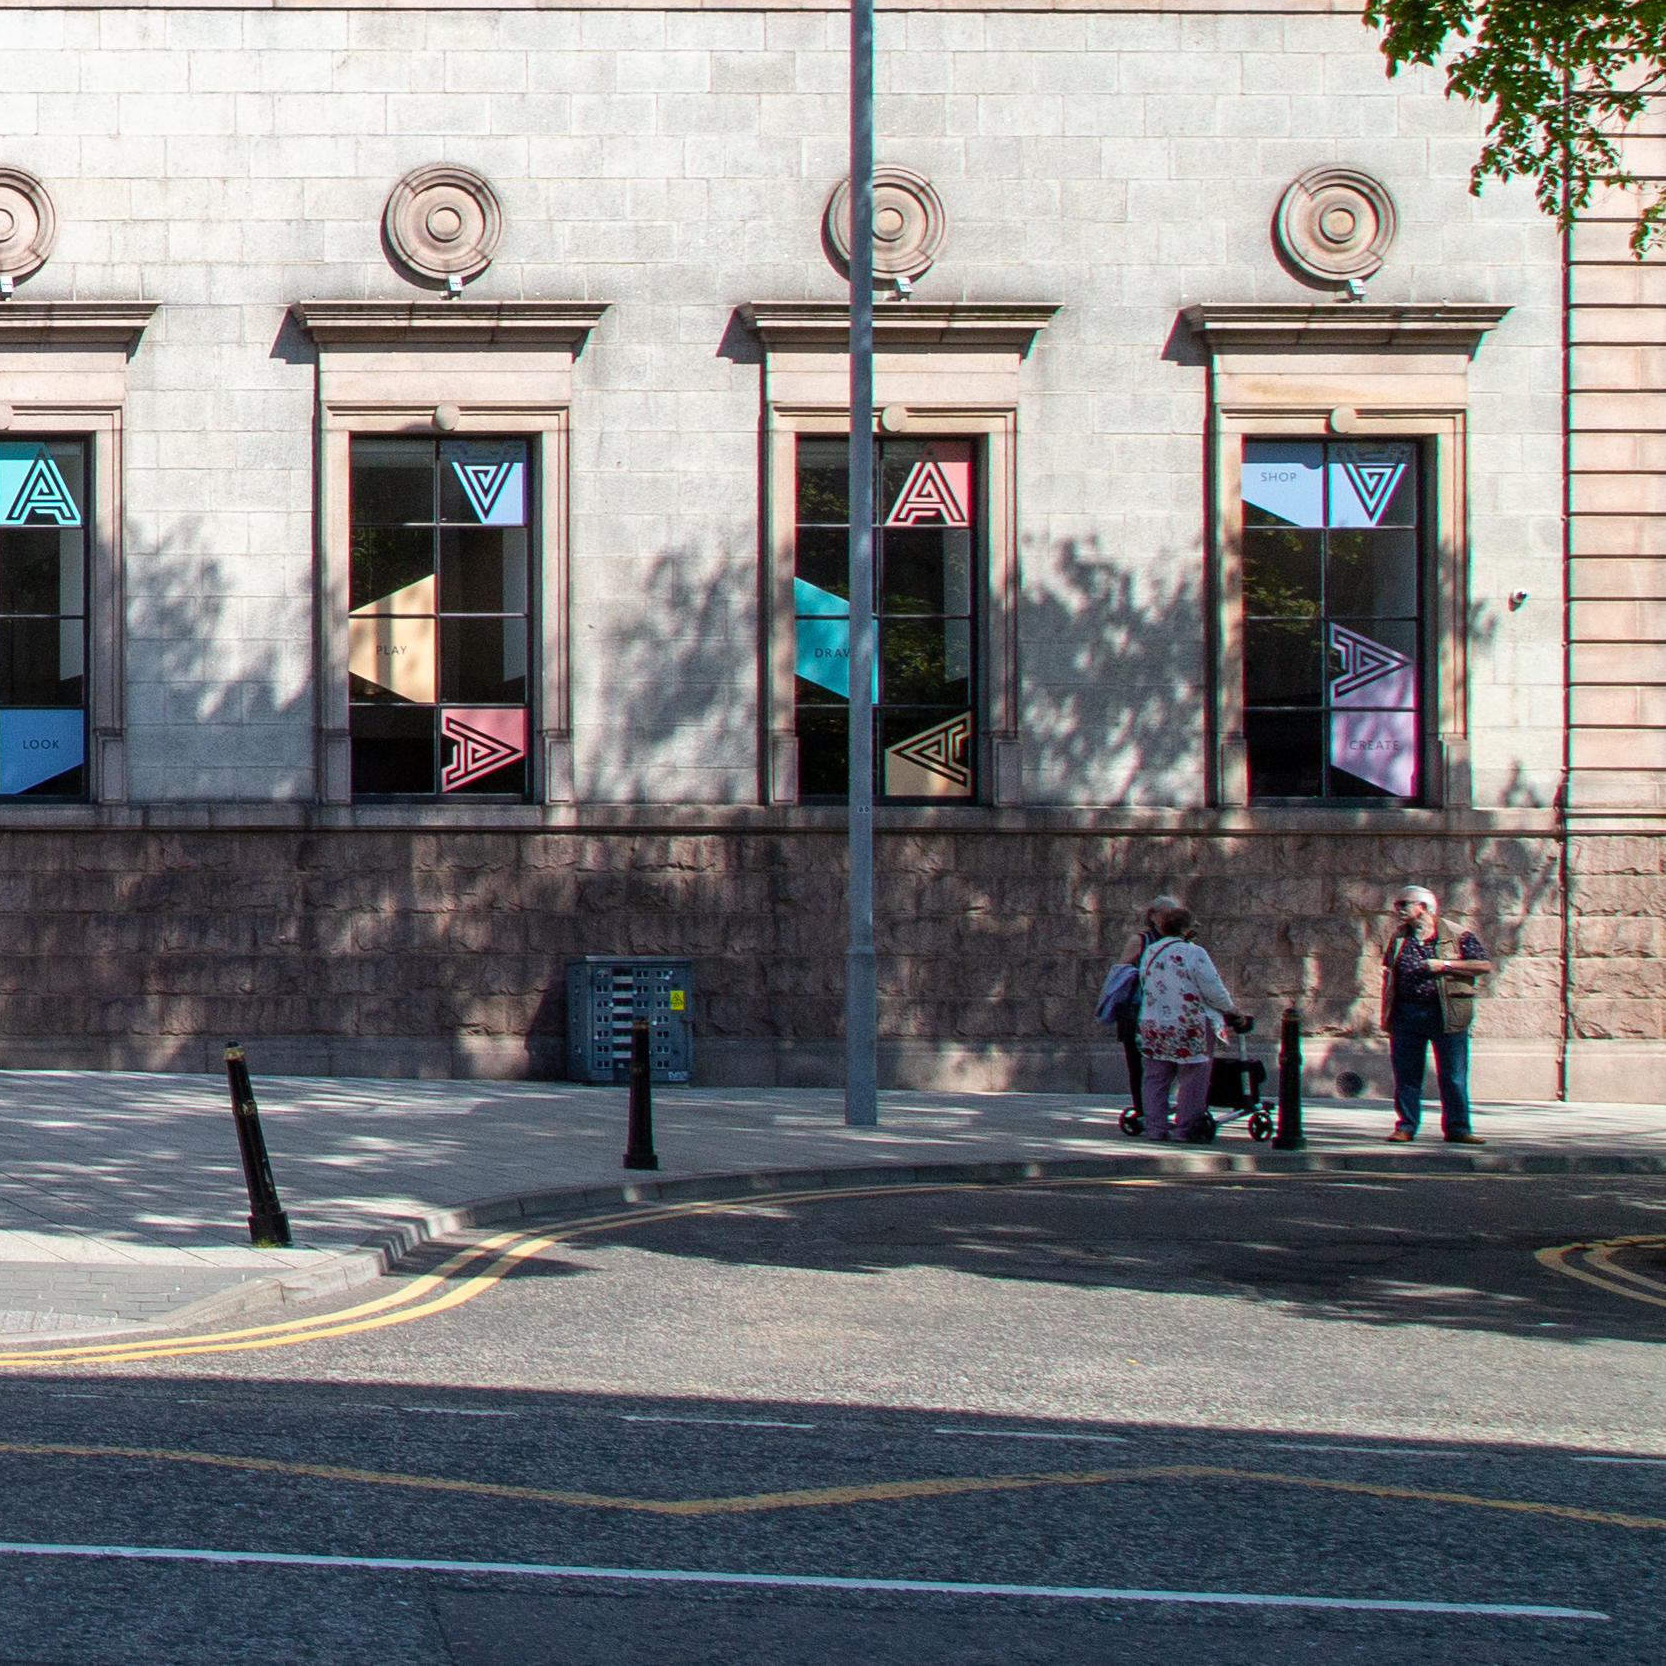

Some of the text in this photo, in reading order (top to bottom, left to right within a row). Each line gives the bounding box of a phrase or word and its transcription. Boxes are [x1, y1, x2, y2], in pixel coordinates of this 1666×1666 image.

[1260, 471, 1297, 483] SHOP
[376, 645, 408, 656] PLAY
[22, 739, 60, 750] LOOK
[1349, 739, 1400, 751] CREATE
